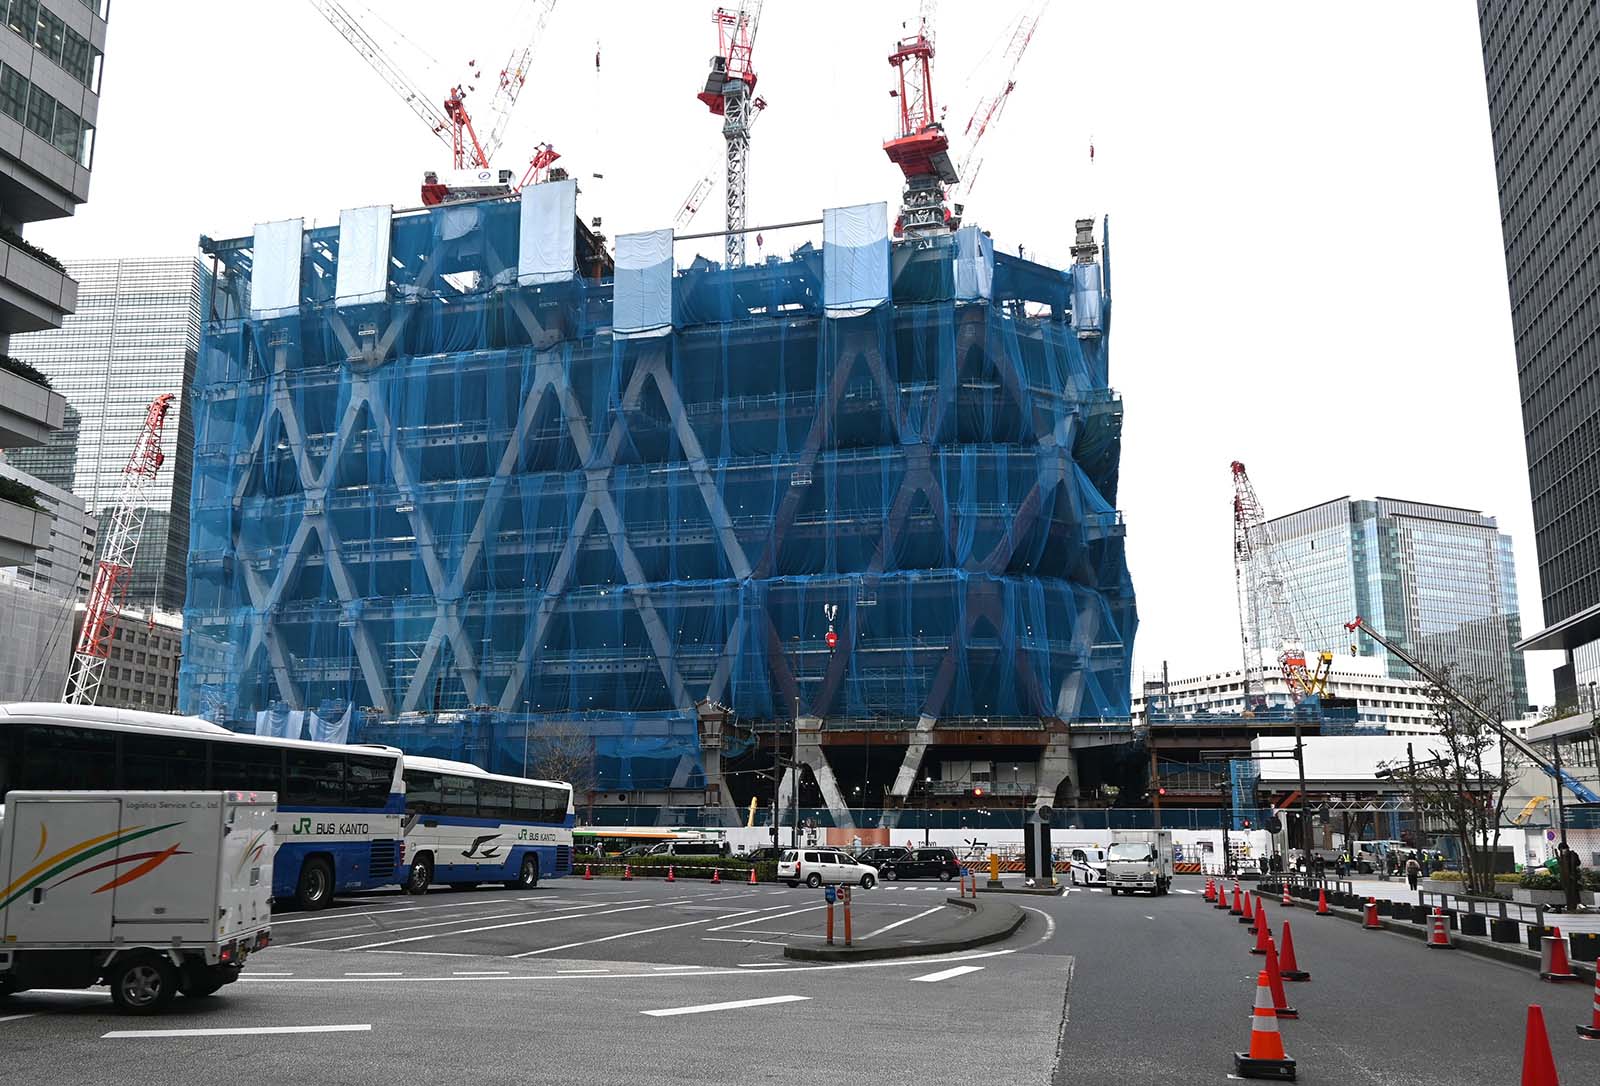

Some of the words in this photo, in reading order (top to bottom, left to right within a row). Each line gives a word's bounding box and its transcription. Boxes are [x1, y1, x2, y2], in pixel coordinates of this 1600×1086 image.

[126, 801, 157, 810] Logistics
[159, 801, 187, 809] Service
[292, 817, 312, 835] JR
[316, 823, 336, 835] BUS
[339, 823, 369, 835] KANTO
[517, 828, 528, 840] JR
[529, 832, 539, 841] BUS
[540, 833, 556, 841] KANTO
